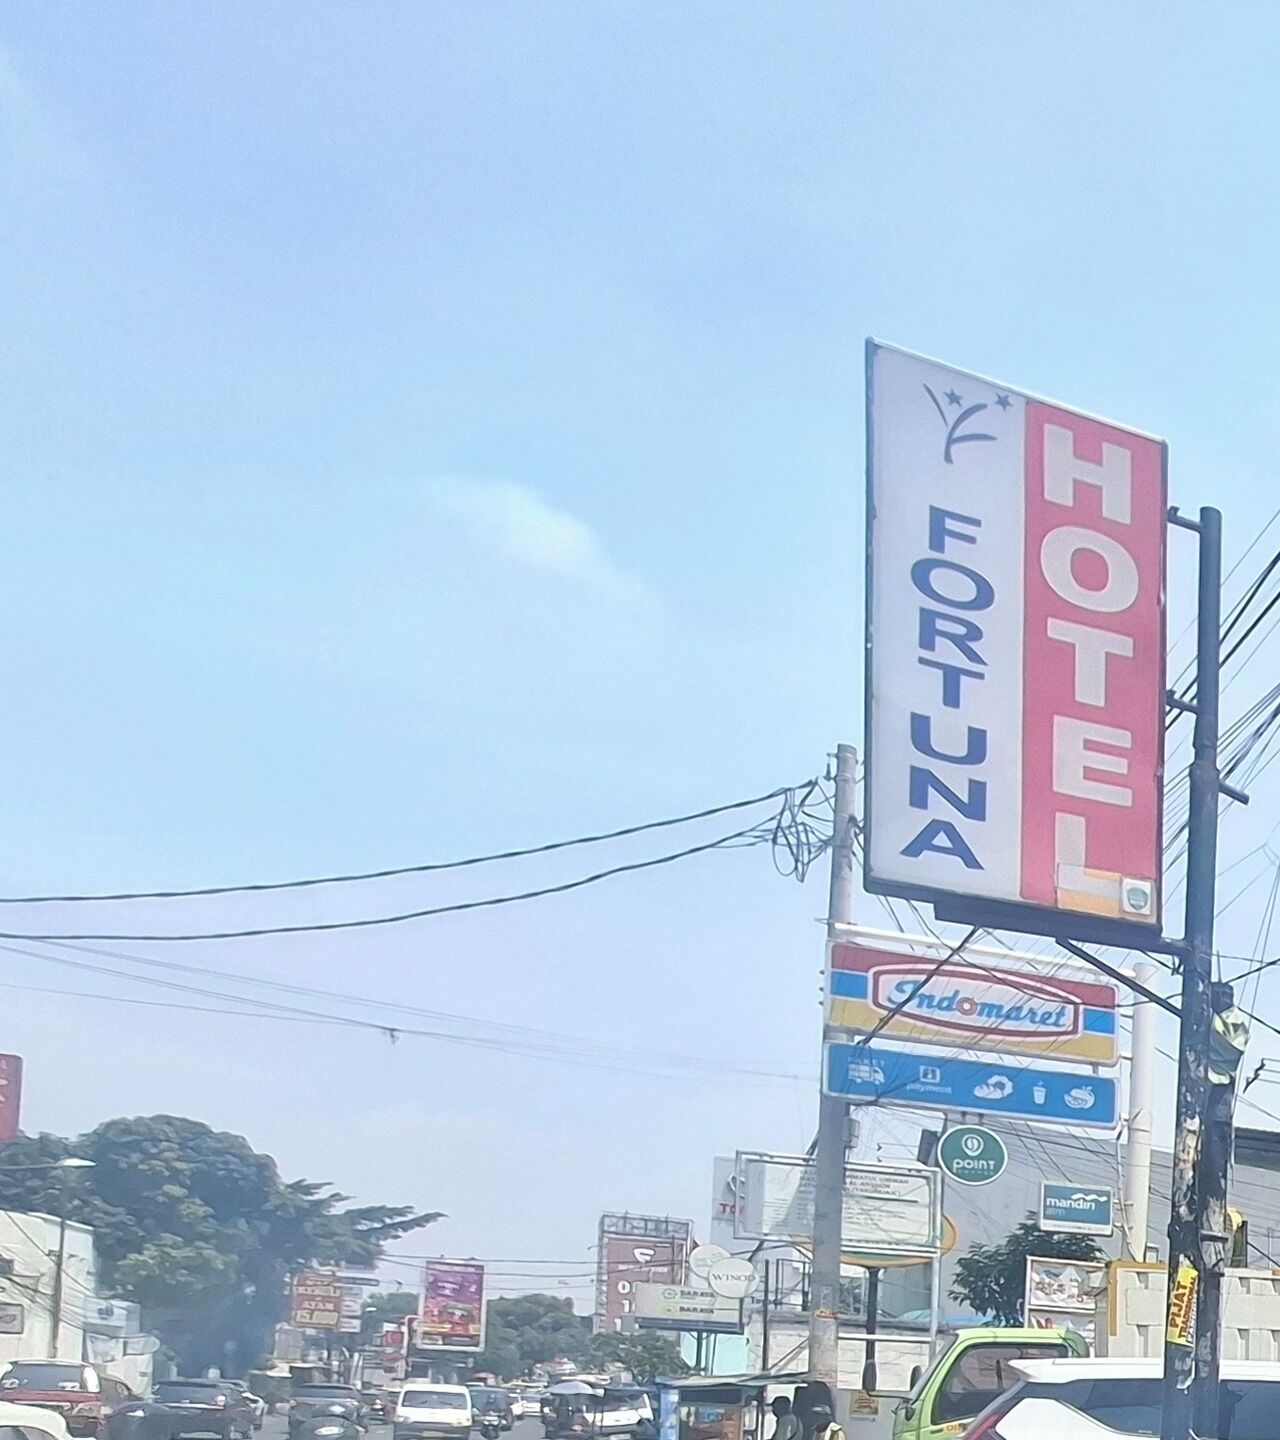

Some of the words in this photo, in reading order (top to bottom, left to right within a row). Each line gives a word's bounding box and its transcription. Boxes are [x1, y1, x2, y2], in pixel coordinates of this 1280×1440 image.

[900, 504, 995, 871] FORTUNA
[1040, 423, 1139, 898] HOTEL
[888, 980, 1067, 1028] Indomaret
[1170, 1280, 1189, 1329] PIJAT
